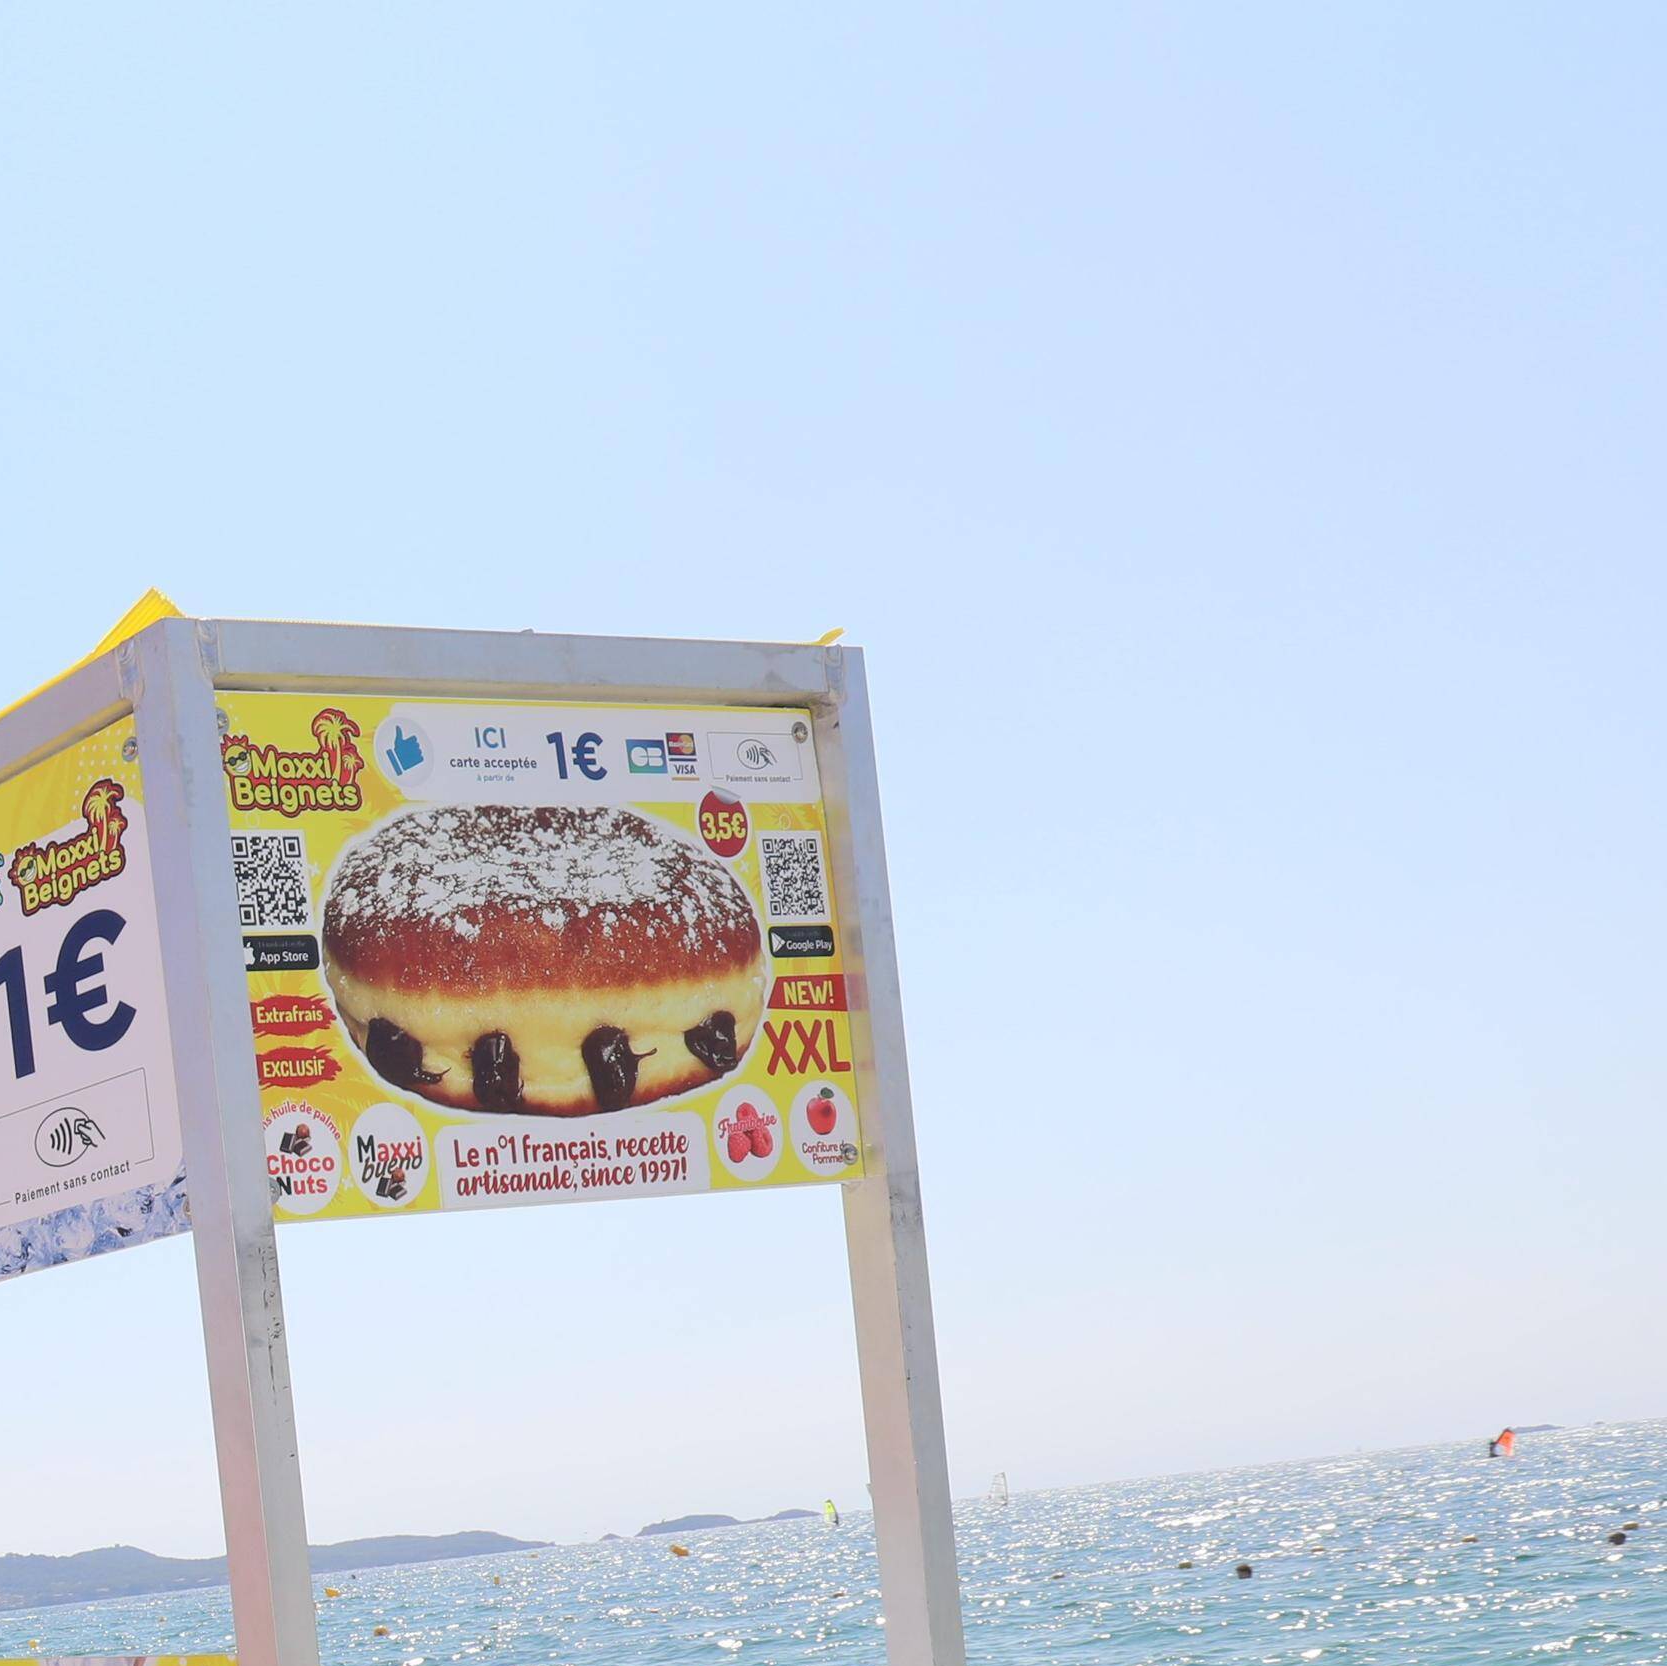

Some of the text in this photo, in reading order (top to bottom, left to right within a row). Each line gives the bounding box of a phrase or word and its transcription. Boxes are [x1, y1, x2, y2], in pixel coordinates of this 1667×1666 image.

[474, 727, 507, 749] ICI
[249, 749, 332, 780] Maxxi
[450, 755, 538, 770] carte acceptée
[546, 732, 608, 781] 1€
[674, 764, 696, 775] VISA
[233, 779, 359, 811] Beignets
[702, 812, 747, 842] 3,5€
[36, 828, 99, 878] Maxxi
[24, 848, 122, 912] Beignets
[259, 950, 309, 964] App Store
[785, 940, 814, 951] Google
[783, 980, 835, 1006] NEW!
[256, 1007, 324, 1024] Extrafrais
[763, 1019, 852, 1076] XXL
[271, 1101, 342, 1141] huile palme
[717, 1112, 777, 1141] Framboise
[357, 1135, 422, 1163] Maxxi
[453, 1139, 480, 1168] Le
[615, 1130, 689, 1158] recette
[267, 1155, 335, 1175] Choco
[456, 1156, 688, 1197] artisanale, since 1997!
[15, 1160, 130, 1206] Paiement sans contact
[277, 1176, 328, 1196] Nuts
